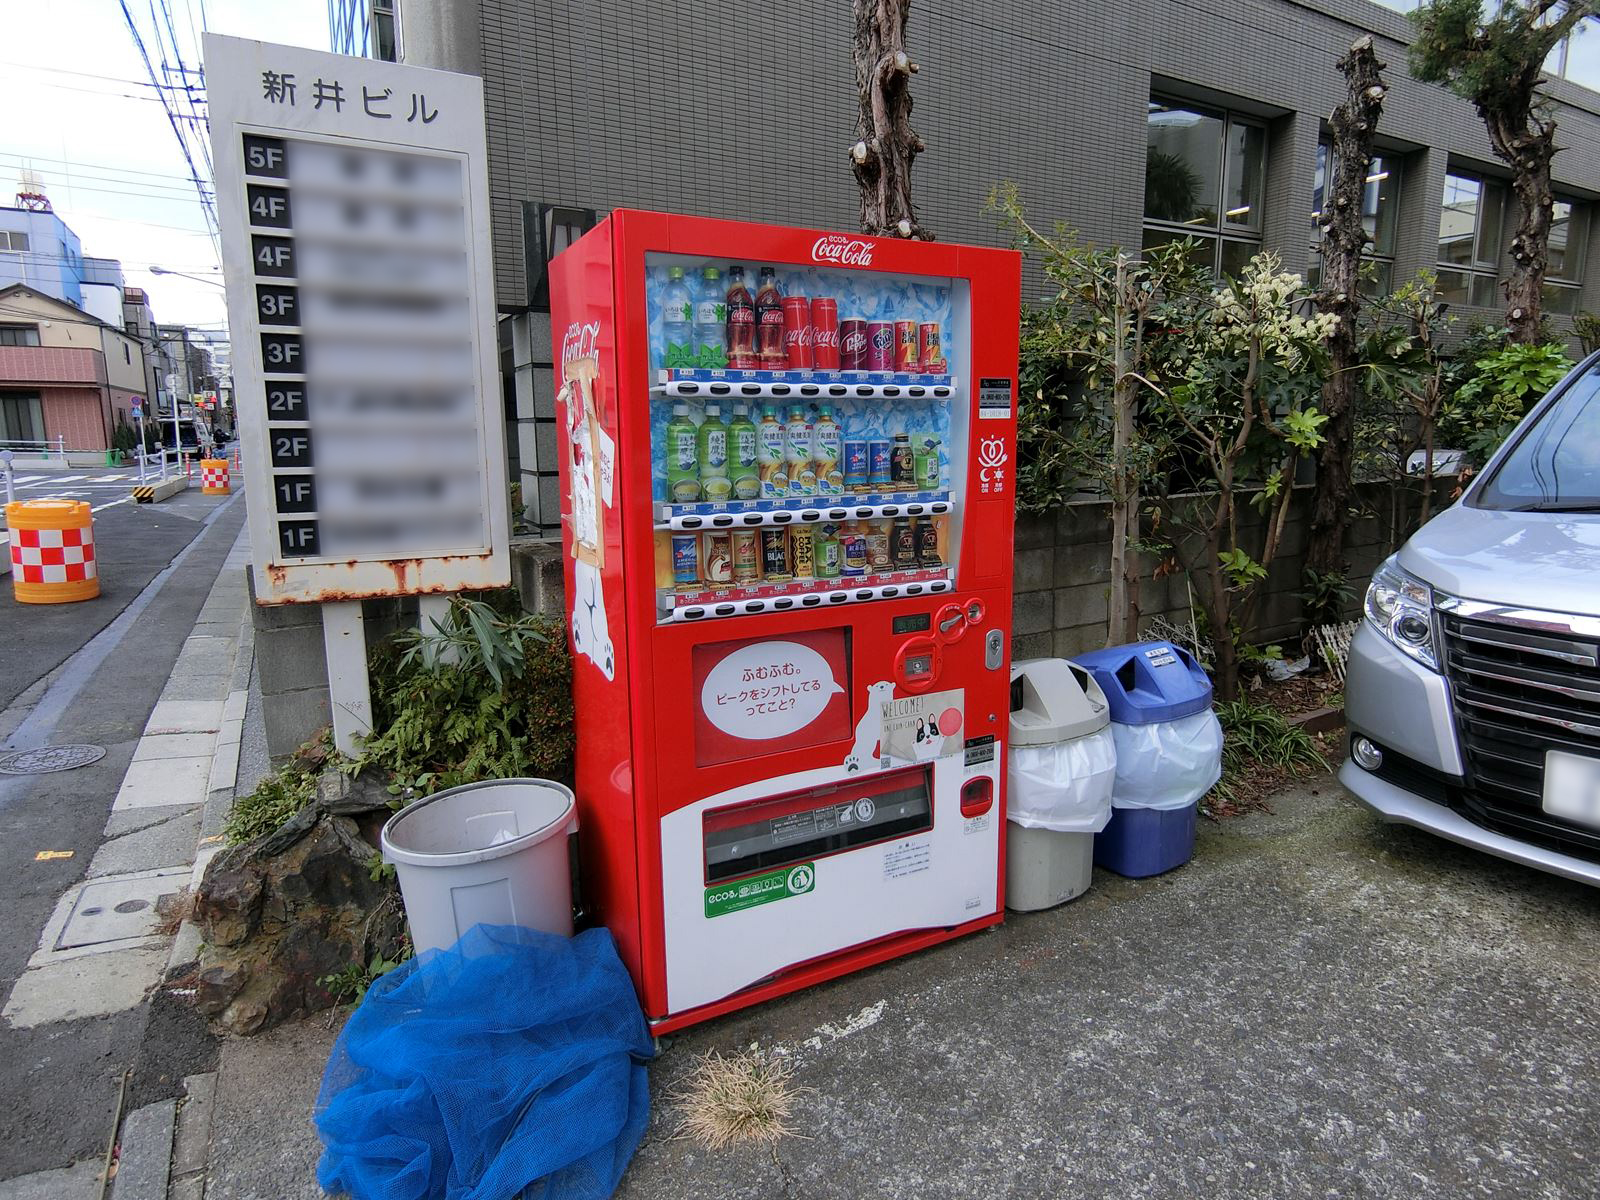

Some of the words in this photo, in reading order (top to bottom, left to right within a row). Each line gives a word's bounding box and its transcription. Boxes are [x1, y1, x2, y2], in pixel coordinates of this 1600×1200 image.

[262, 70, 439, 124] 新井ビル
[249, 147, 283, 169] 5F
[252, 197, 285, 218] 4F
[258, 246, 291, 267] 4F
[811, 237, 877, 266] Coca-Cola
[261, 295, 294, 316] 3F
[268, 342, 300, 364] 3F
[270, 391, 302, 412] 2F
[276, 437, 308, 458] 2F
[280, 482, 311, 502] 1F
[284, 528, 314, 548] 1F
[742, 662, 801, 682] ふむふむ。
[716, 679, 821, 706] ピークをシフトしてる
[746, 698, 796, 716] ってこと?
